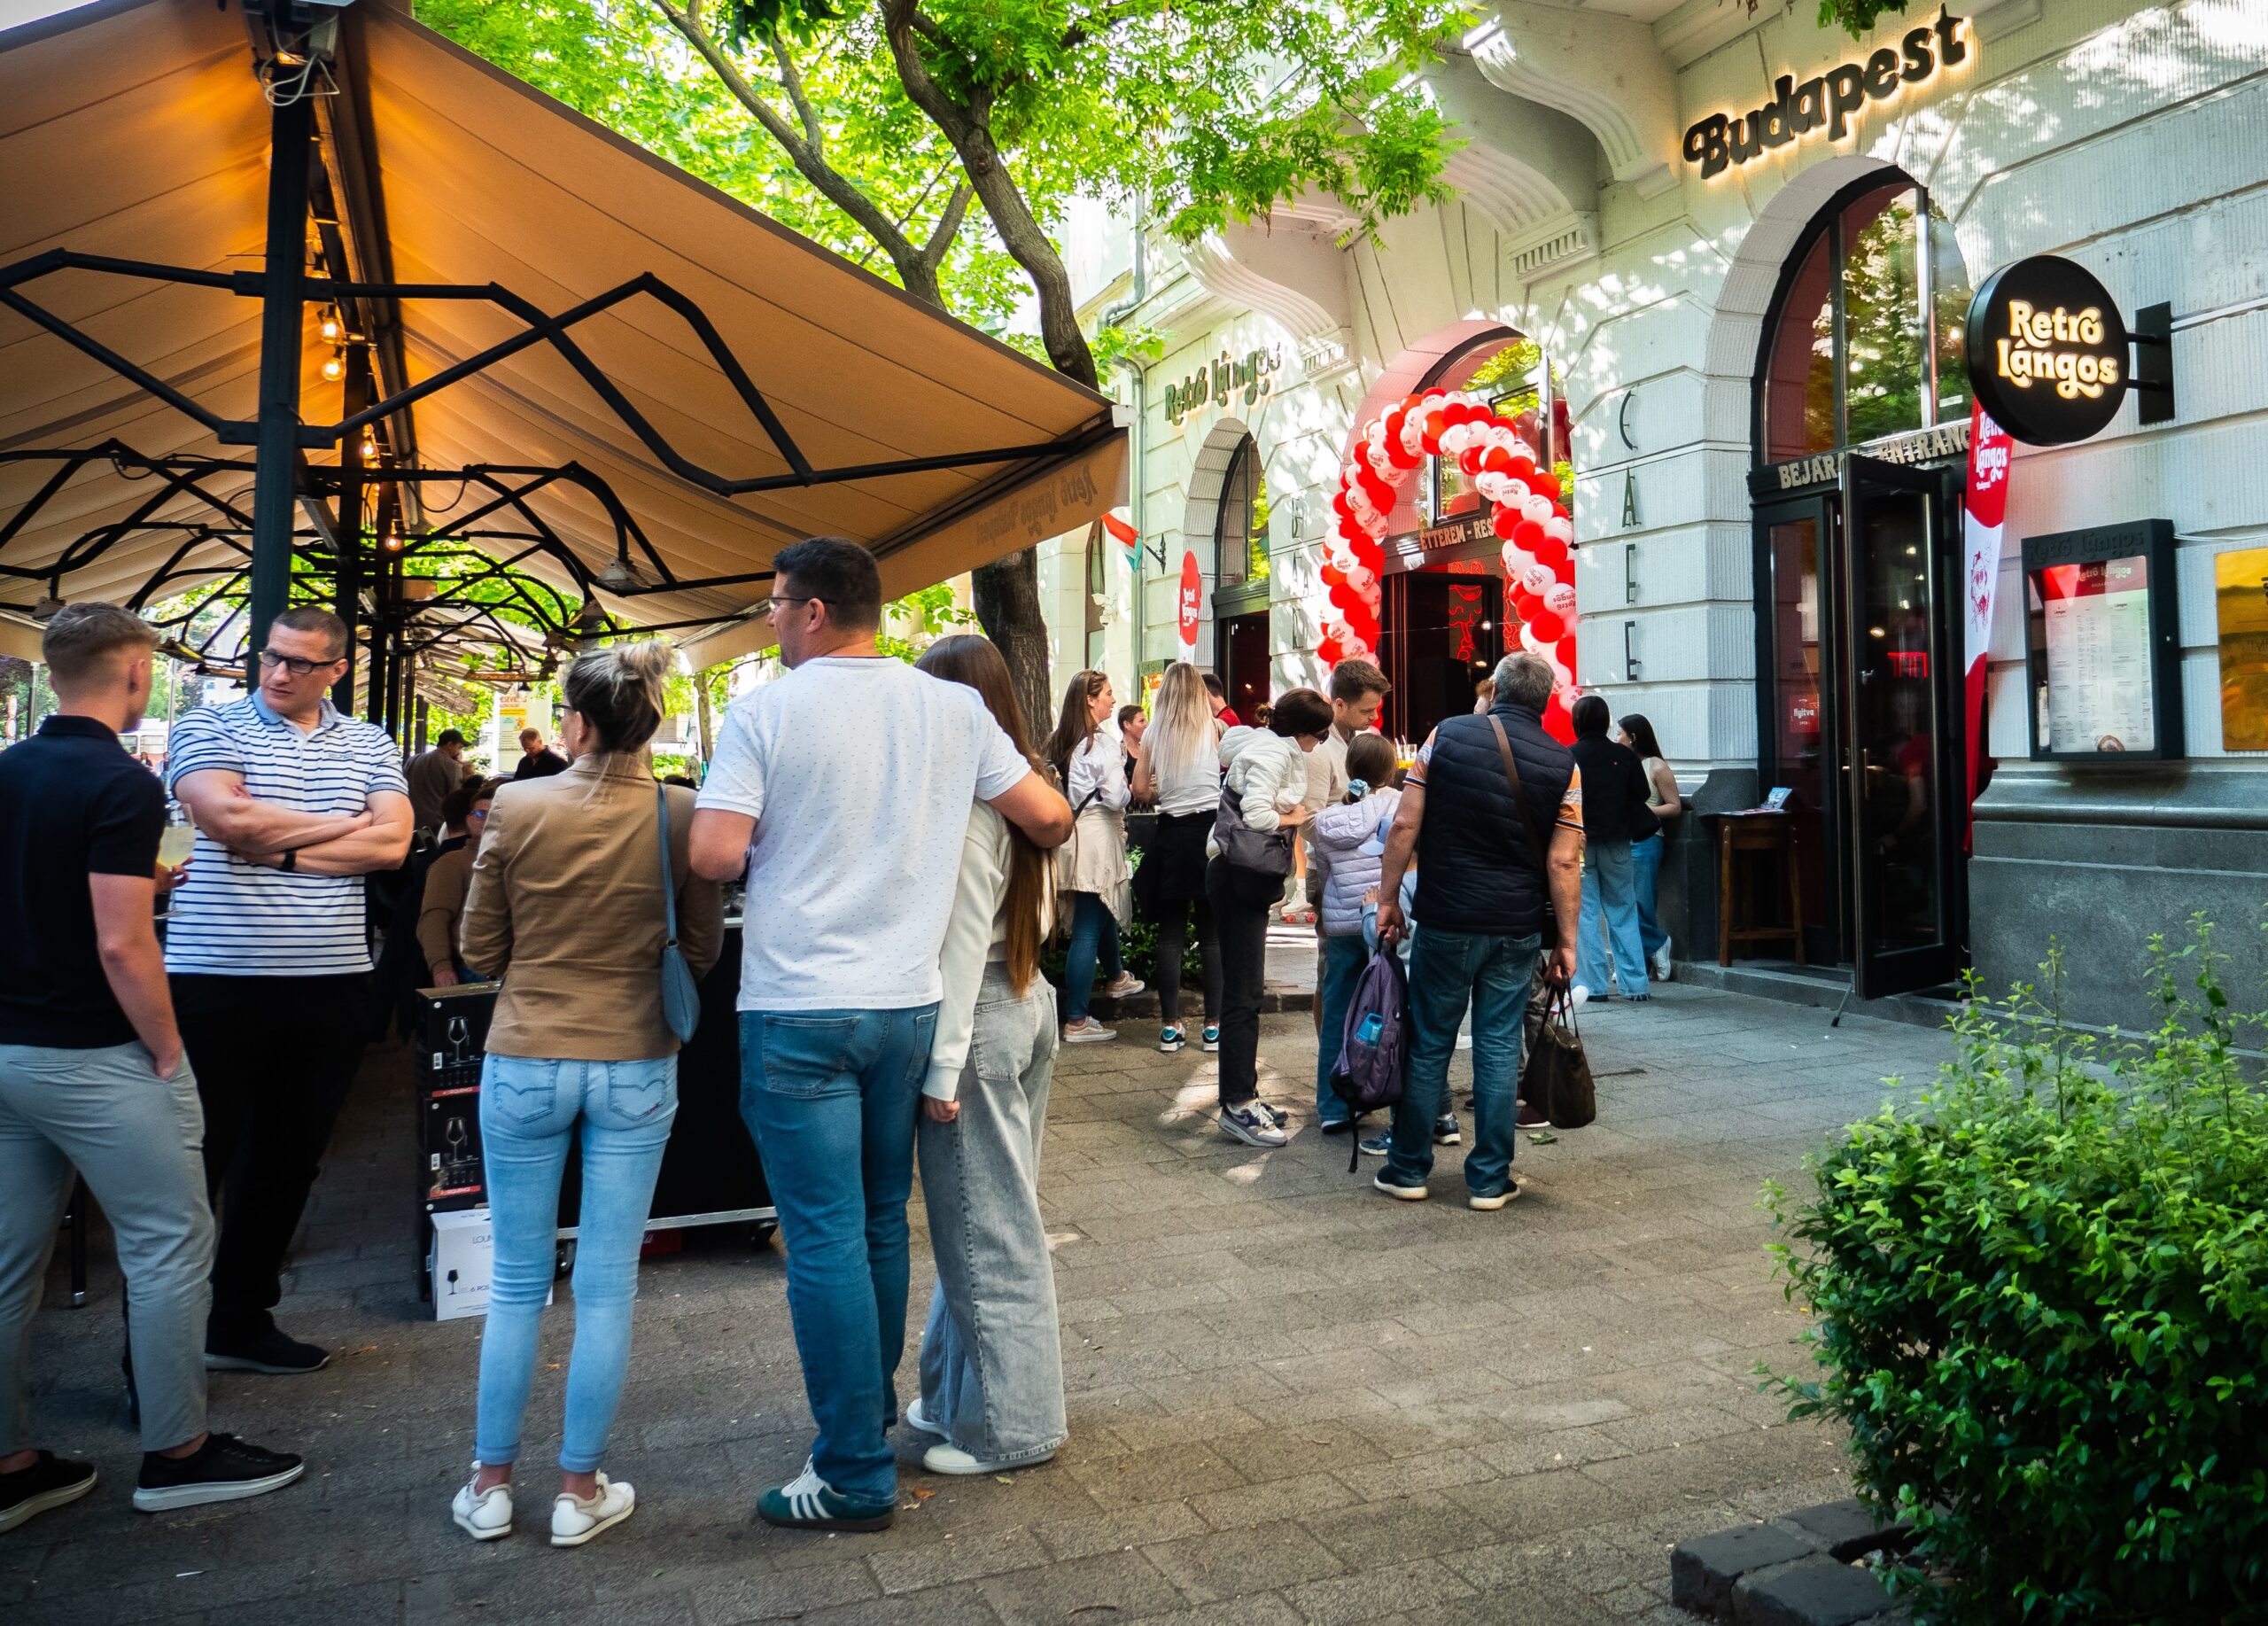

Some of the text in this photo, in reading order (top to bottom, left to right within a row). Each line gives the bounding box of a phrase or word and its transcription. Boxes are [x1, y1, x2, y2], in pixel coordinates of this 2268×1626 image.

[1683, 3, 1965, 179] Budapest
[2008, 300, 2105, 348] Retró
[1996, 338, 2119, 399] lángos
[1876, 424, 1969, 465] ENTRANC
[1553, 592, 1575, 603] ángos
